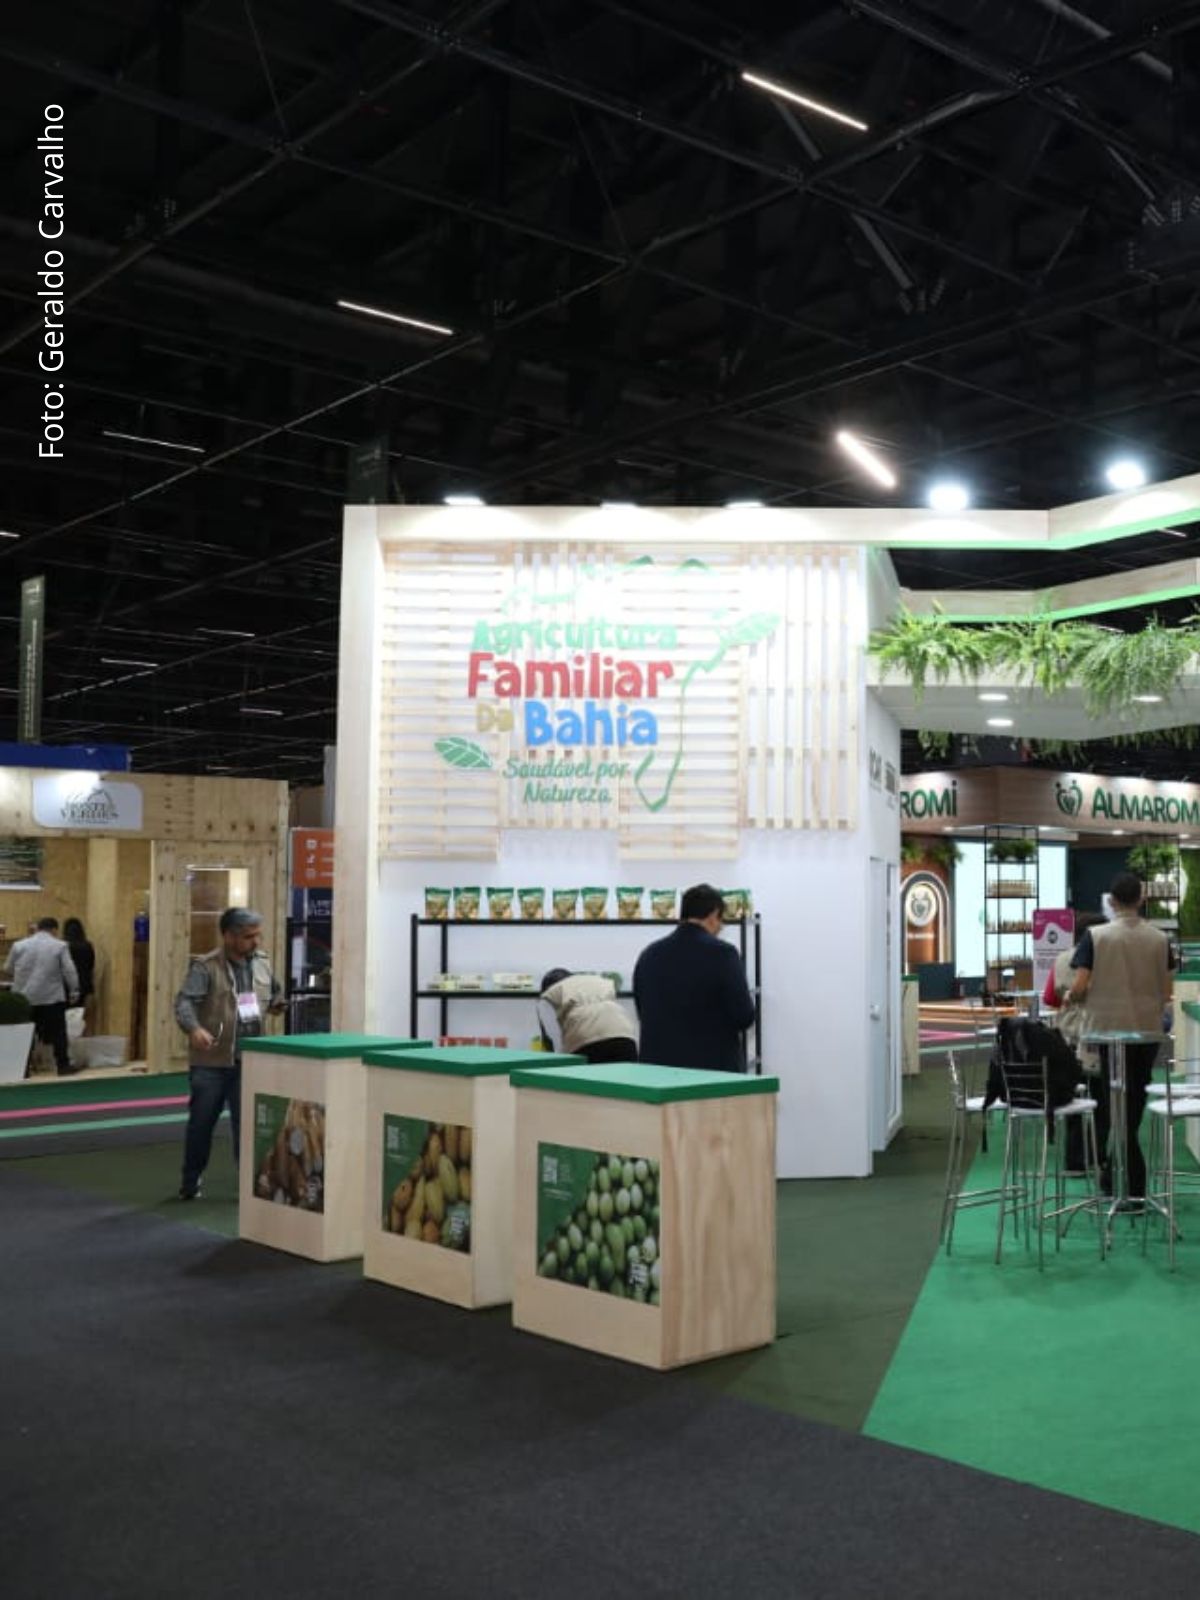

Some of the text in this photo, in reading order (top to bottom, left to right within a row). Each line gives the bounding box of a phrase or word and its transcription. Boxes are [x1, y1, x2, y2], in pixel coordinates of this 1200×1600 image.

[471, 617, 679, 655] Agricultura
[467, 652, 674, 699] Familiar
[524, 701, 658, 747] Bahia
[595, 763, 630, 784] por
